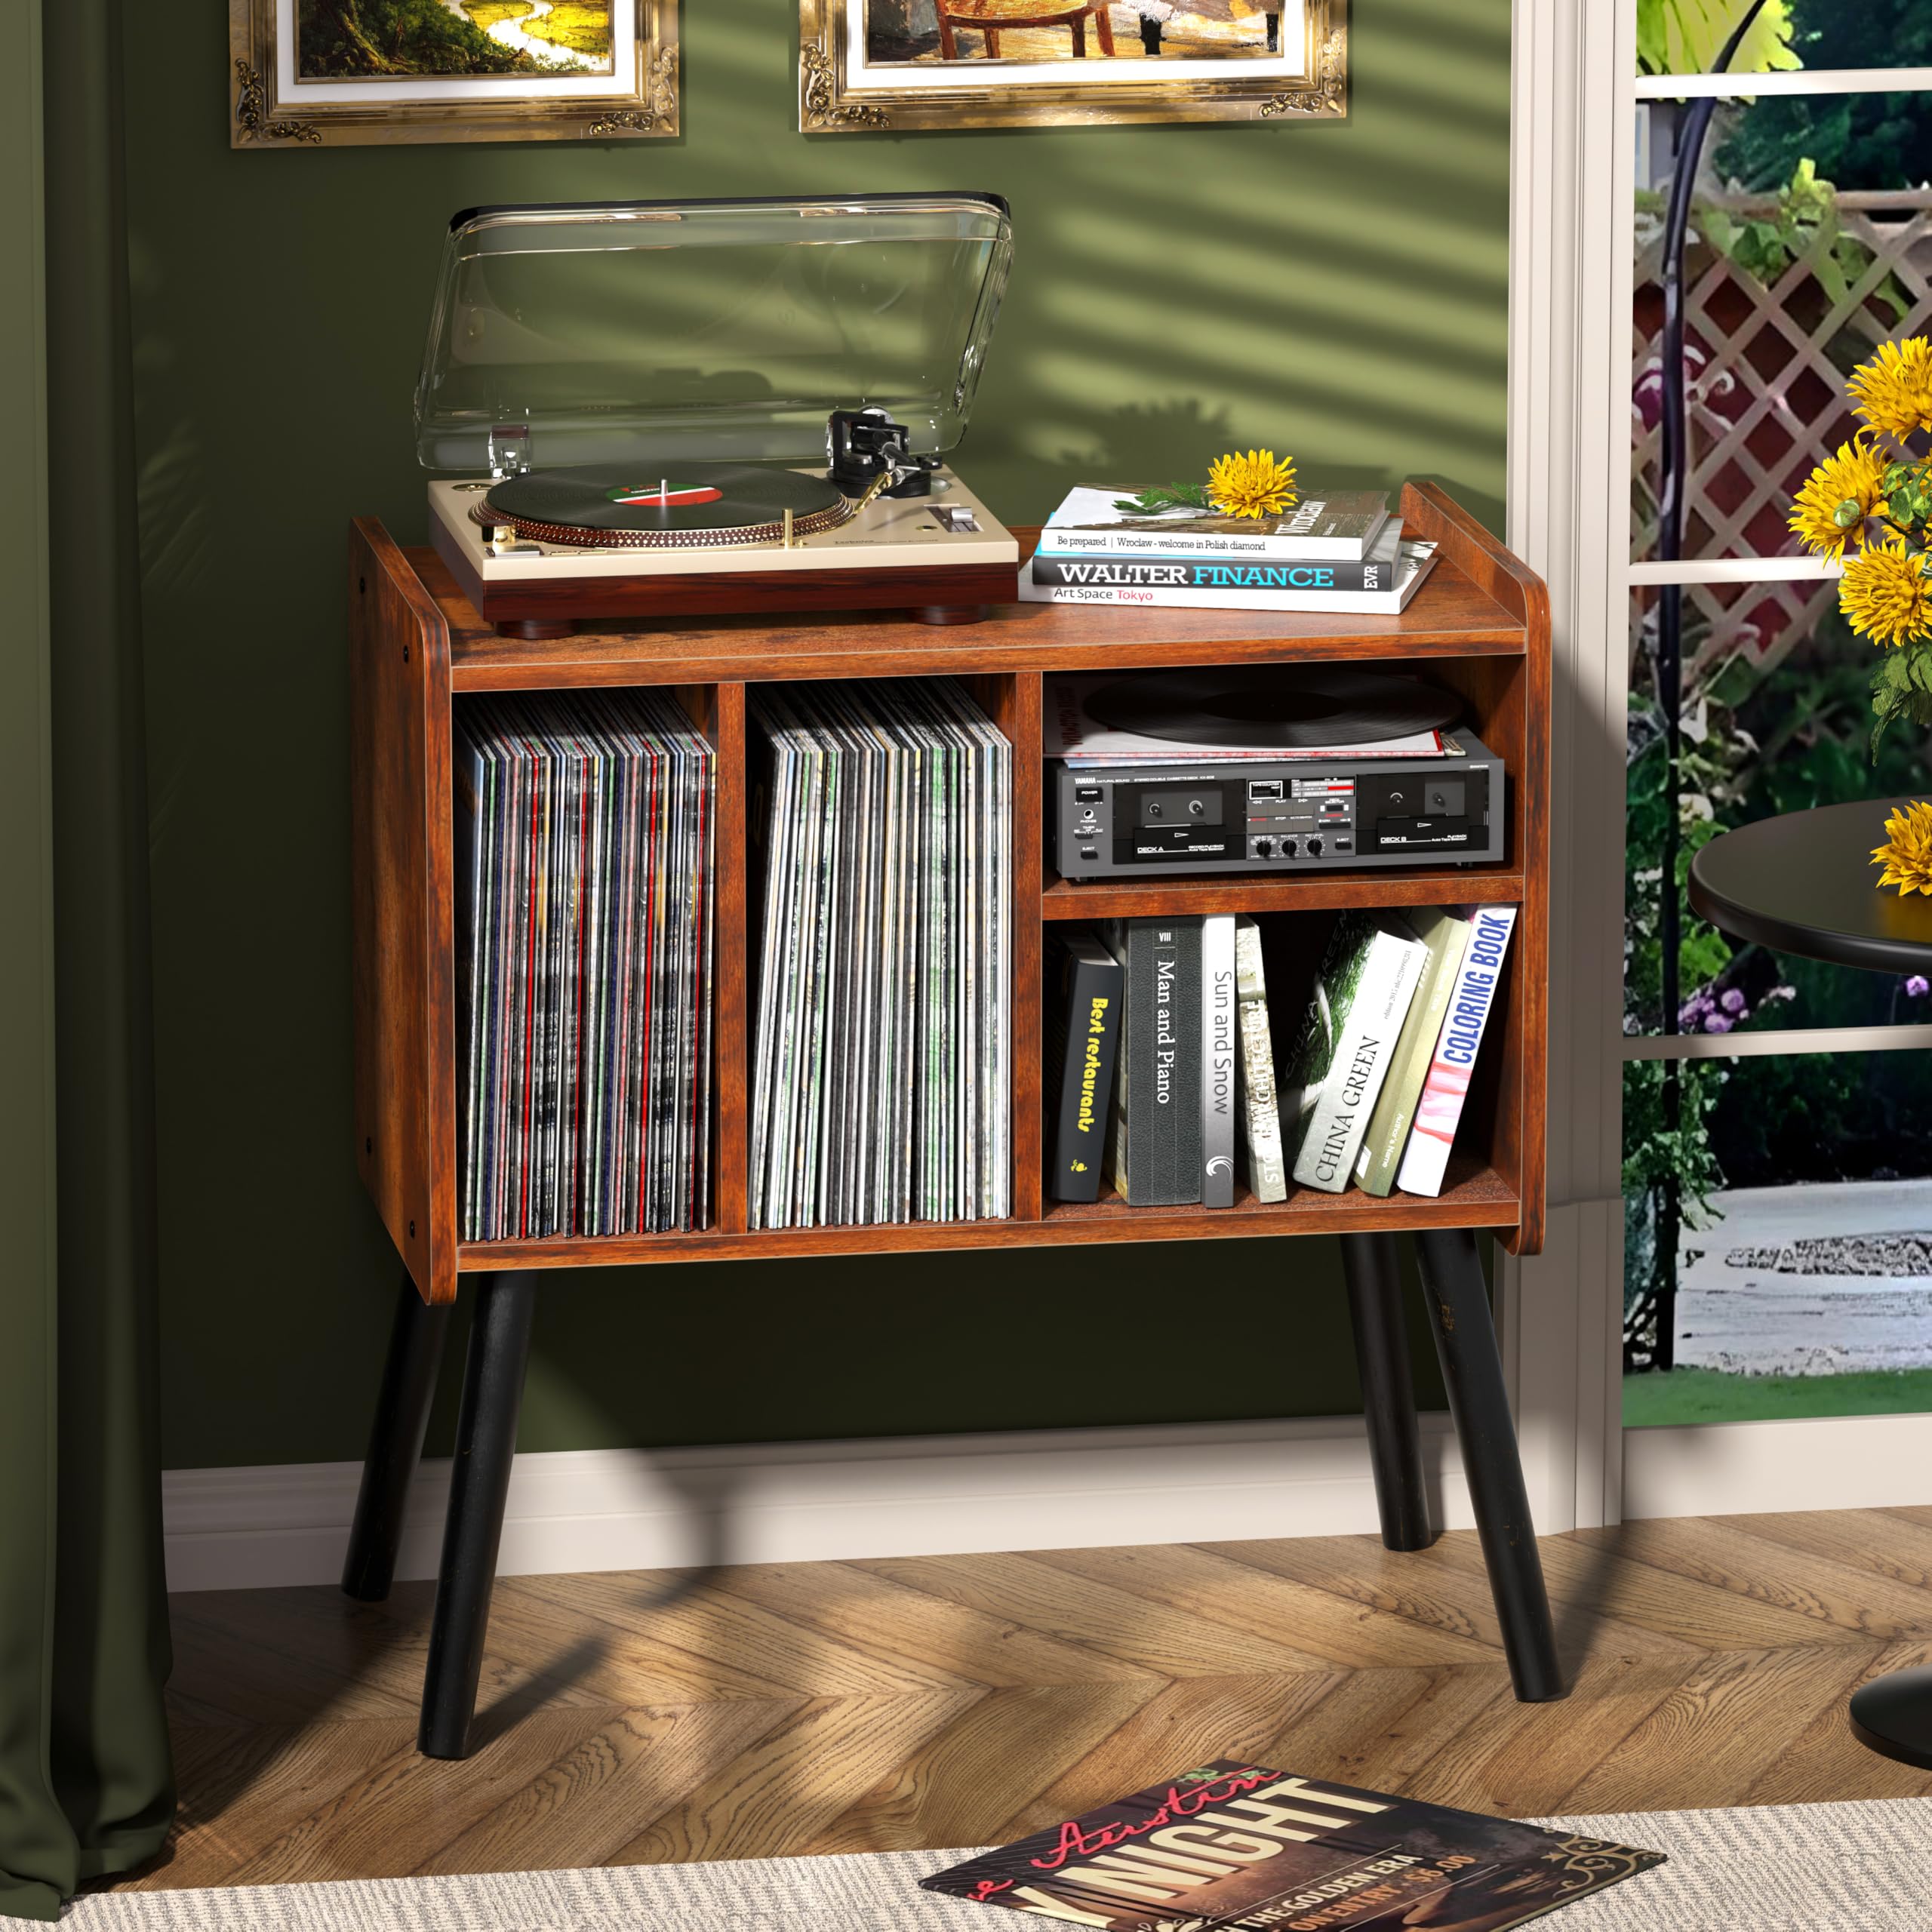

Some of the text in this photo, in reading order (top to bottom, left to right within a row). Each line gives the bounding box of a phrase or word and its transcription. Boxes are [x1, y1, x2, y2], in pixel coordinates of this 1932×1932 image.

[1057, 535, 1069, 545] Be
[1069, 537, 1107, 548] prepared
[1117, 537, 1153, 548] Wroclaw
[1158, 539, 1195, 549] welcome
[1195, 539, 1204, 549] in
[1205, 540, 1229, 550] Polish
[1229, 540, 1266, 551] diamond
[1057, 563, 1334, 587] WALTER FINANCE
[1054, 587, 1154, 603] Art Space Tokyo
[1364, 565, 1379, 589] EVR
[1074, 777, 1097, 785] YAMAHA
[1158, 932, 1171, 943] VIII
[1443, 971, 1495, 1064] COLORING
[1469, 913, 1510, 968] BOOK
[1157, 960, 1176, 1104] Man and Piano
[1213, 971, 1233, 1115] Sun and Snow
[1077, 997, 1109, 1133] Best restaurants
[1315, 1034, 1381, 1182] CHINA GREEN
[1259, 1129, 1280, 1183] STOE
[1232, 1854, 1424, 1928] THE GOLDEN ERA
[1288, 1855, 1477, 1931] ON ENTRY $6.00
